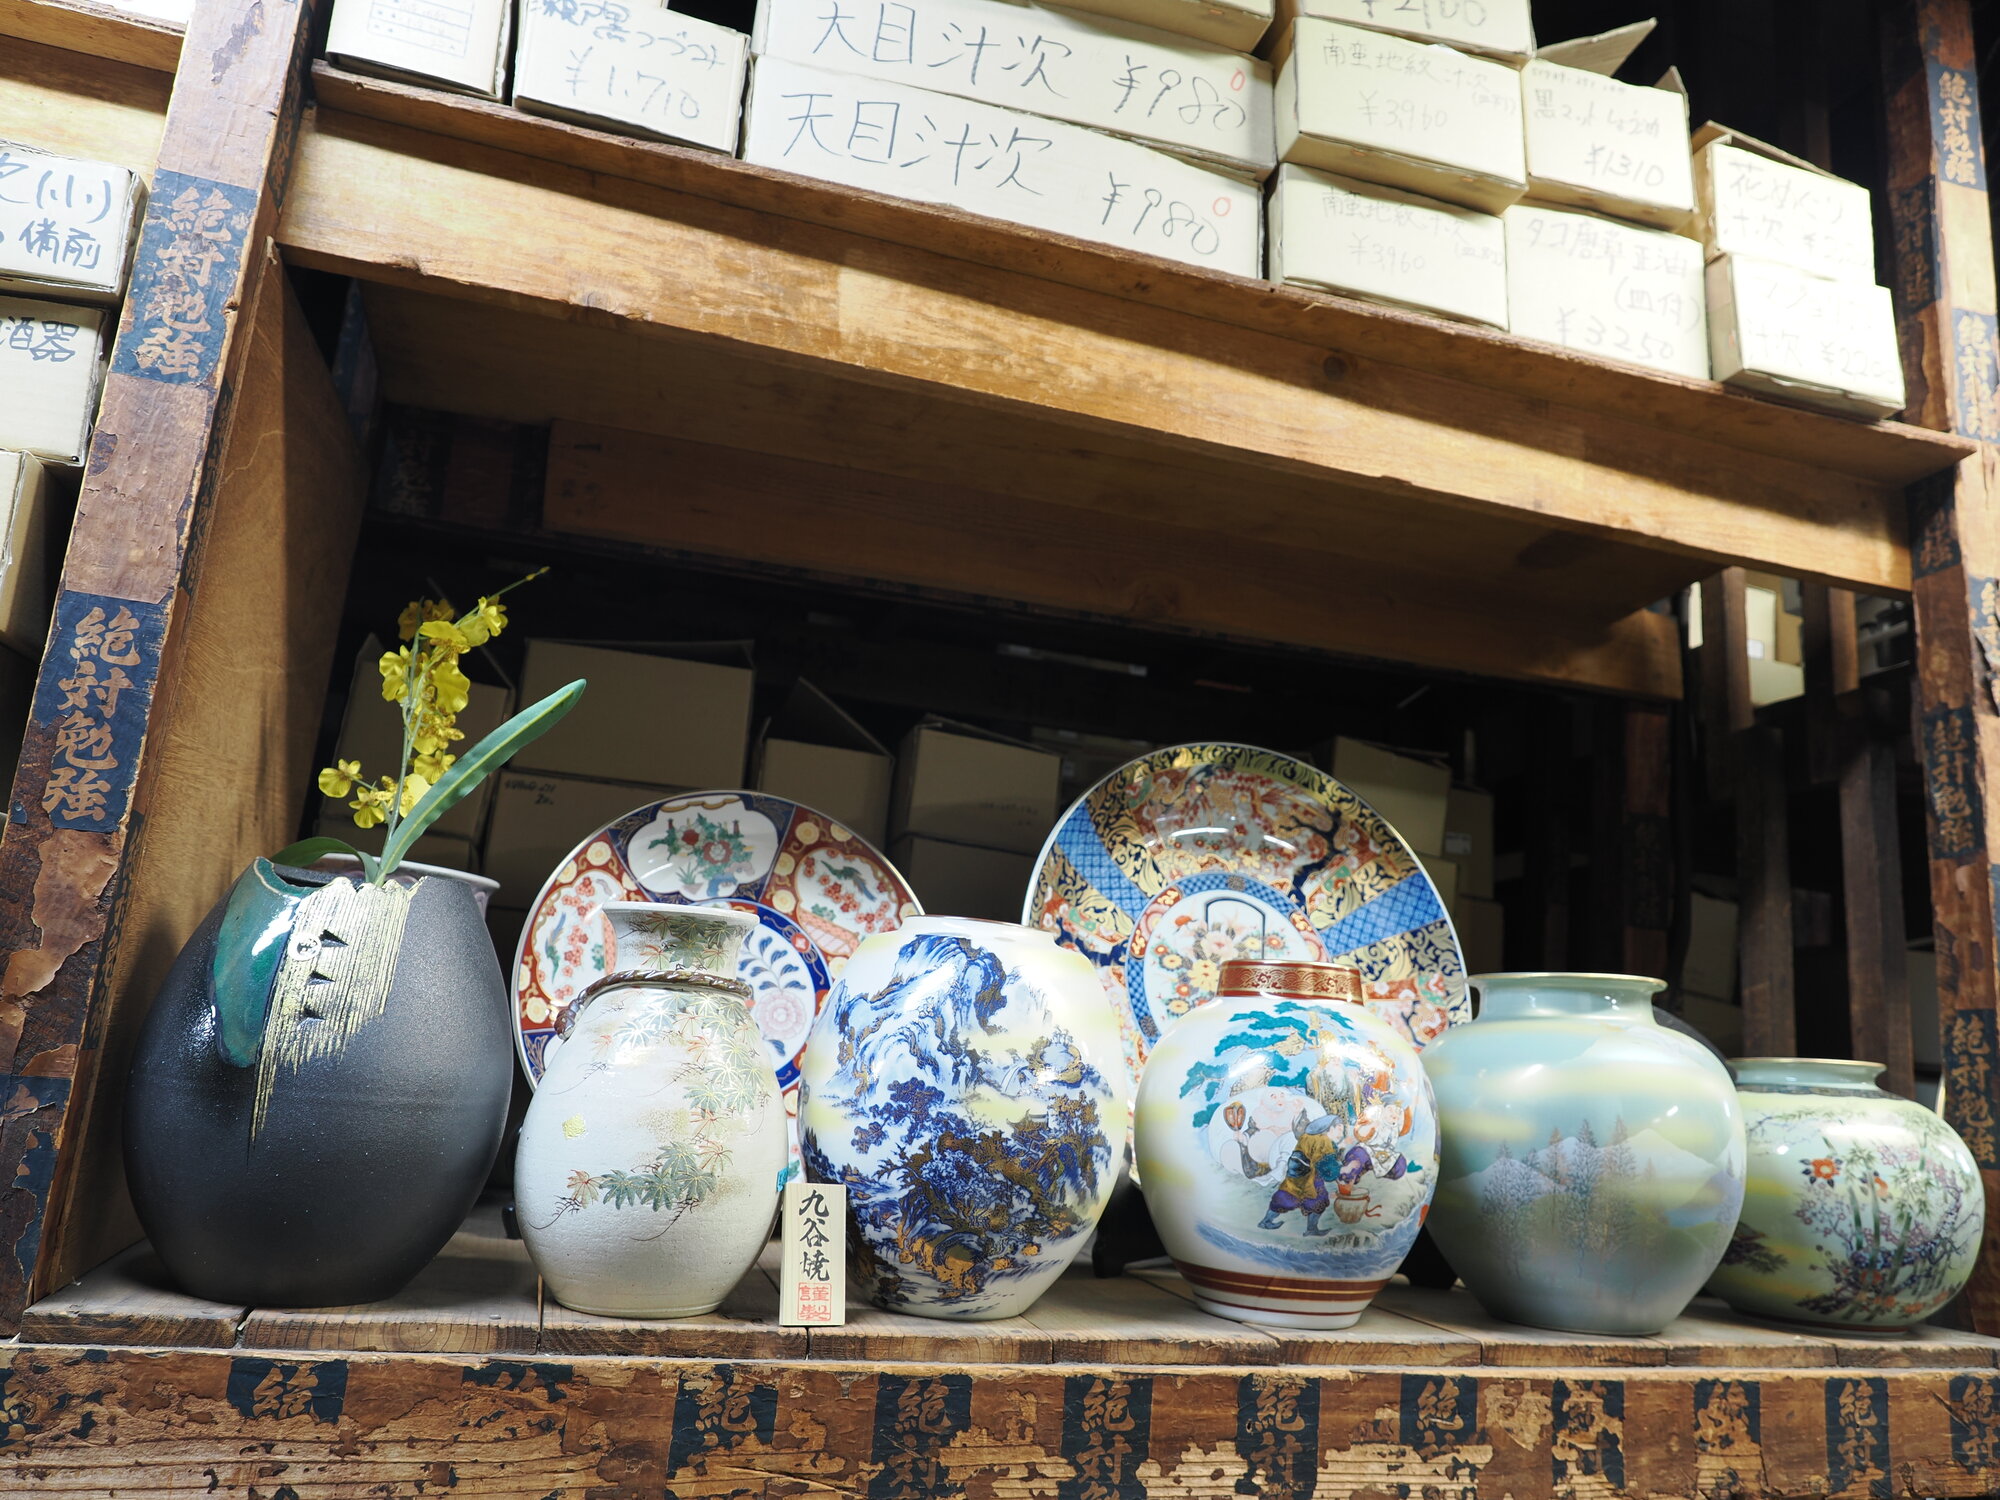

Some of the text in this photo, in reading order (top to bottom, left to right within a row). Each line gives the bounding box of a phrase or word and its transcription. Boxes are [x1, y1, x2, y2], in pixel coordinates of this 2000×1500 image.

[781, 93, 1053, 196] 天目汁次
[799, 1189, 830, 1282] 九谷焼
